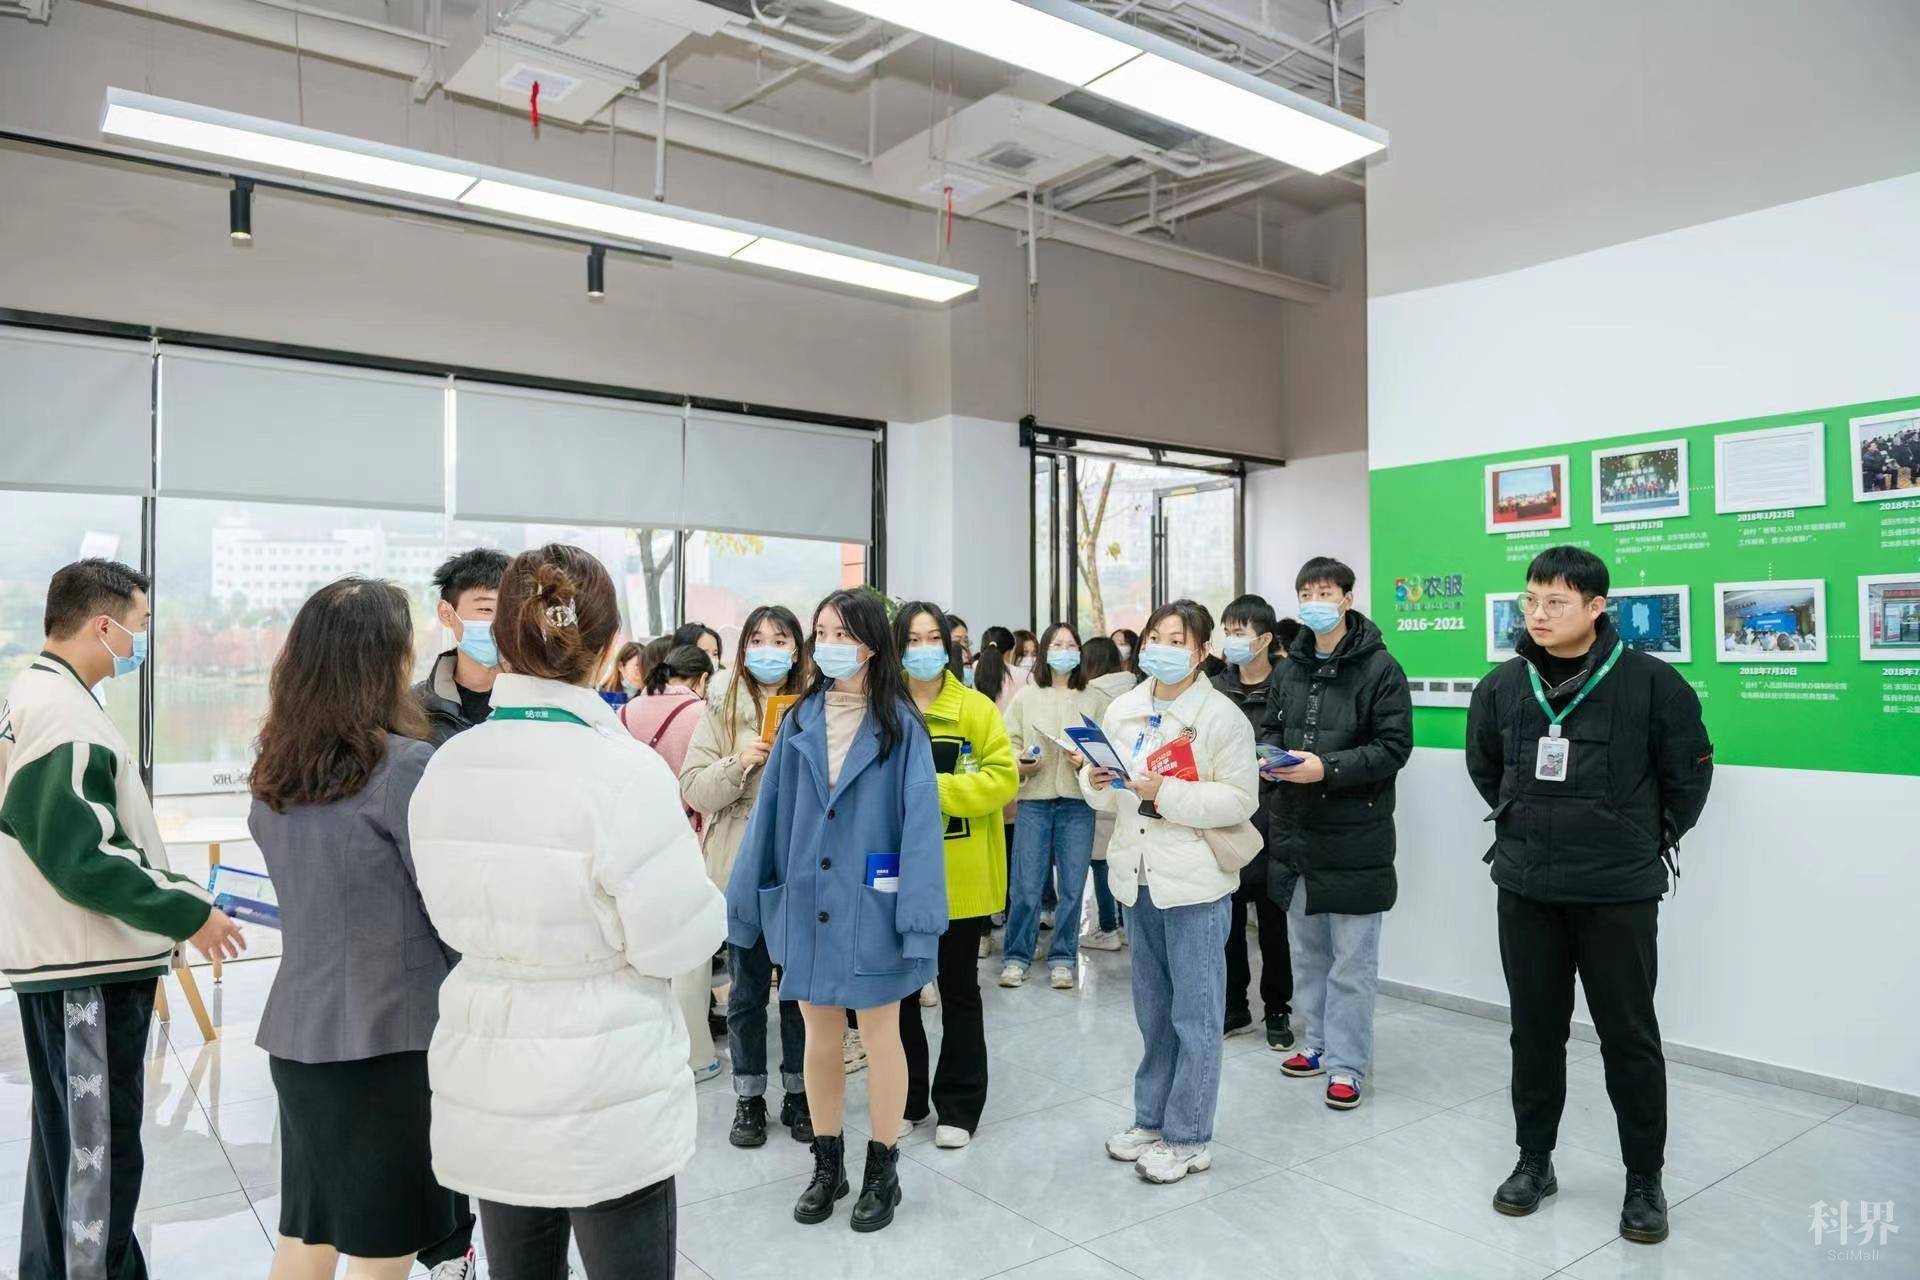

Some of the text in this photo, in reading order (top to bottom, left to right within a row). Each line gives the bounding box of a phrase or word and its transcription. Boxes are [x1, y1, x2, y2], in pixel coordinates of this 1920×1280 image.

[1737, 510, 1794, 522] 2018年1月23日
[1739, 667, 1797, 676] 2018年7月10日
